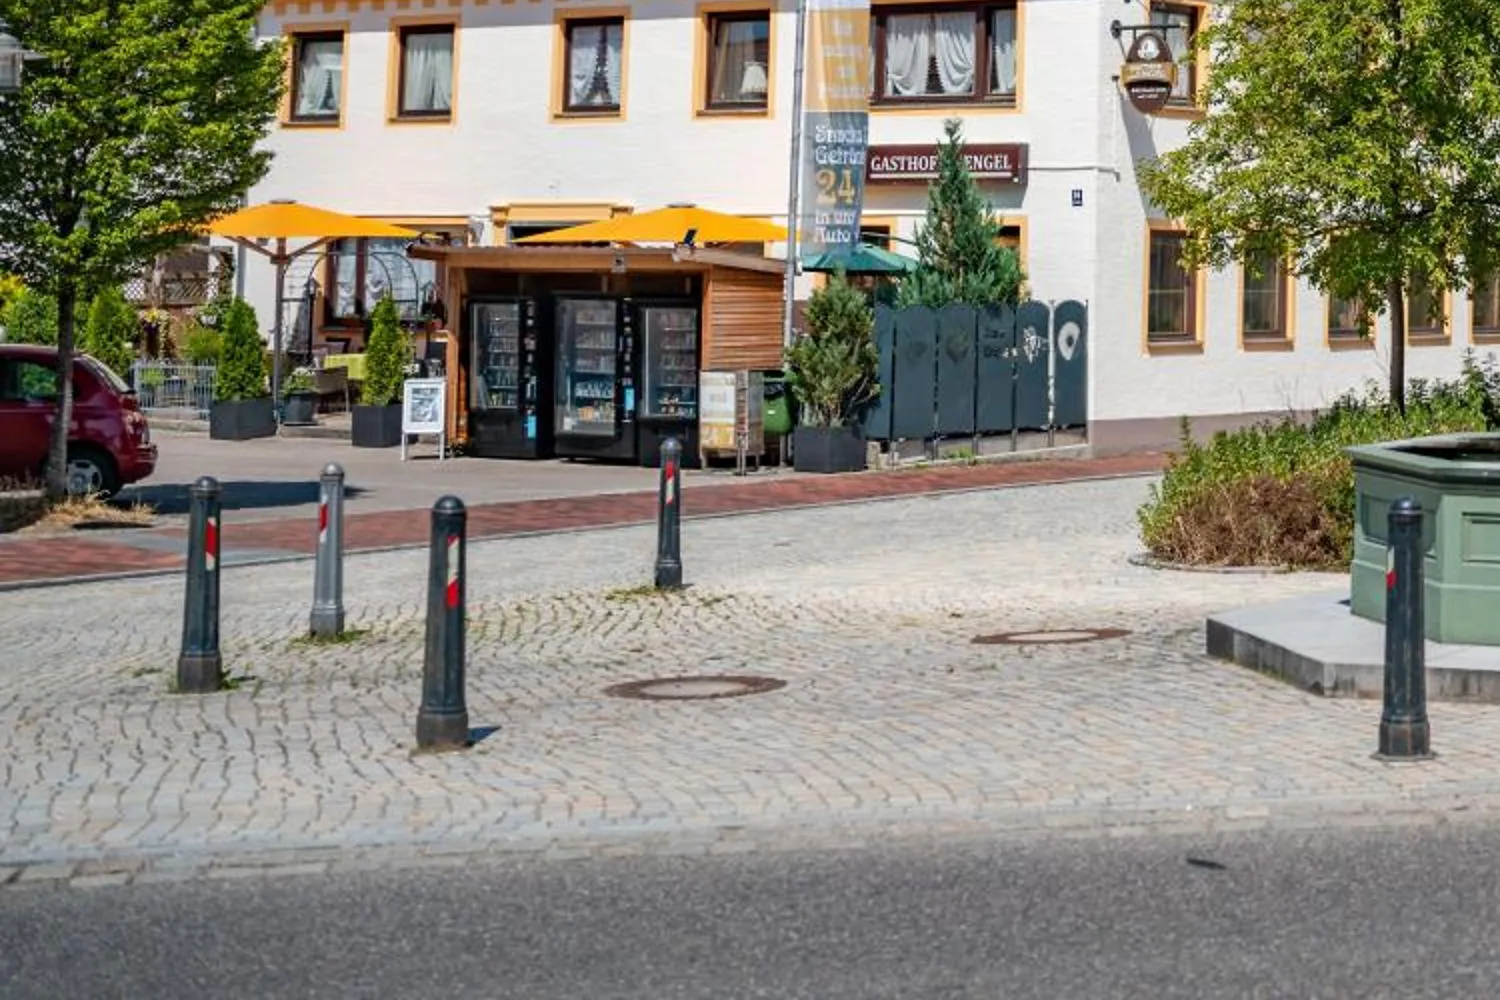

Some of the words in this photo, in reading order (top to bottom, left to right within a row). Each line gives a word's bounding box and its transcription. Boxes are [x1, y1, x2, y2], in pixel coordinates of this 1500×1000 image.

[871, 155, 937, 171] GASTHOF
[965, 154, 1012, 170] ENGEL
[815, 168, 856, 206] 24
